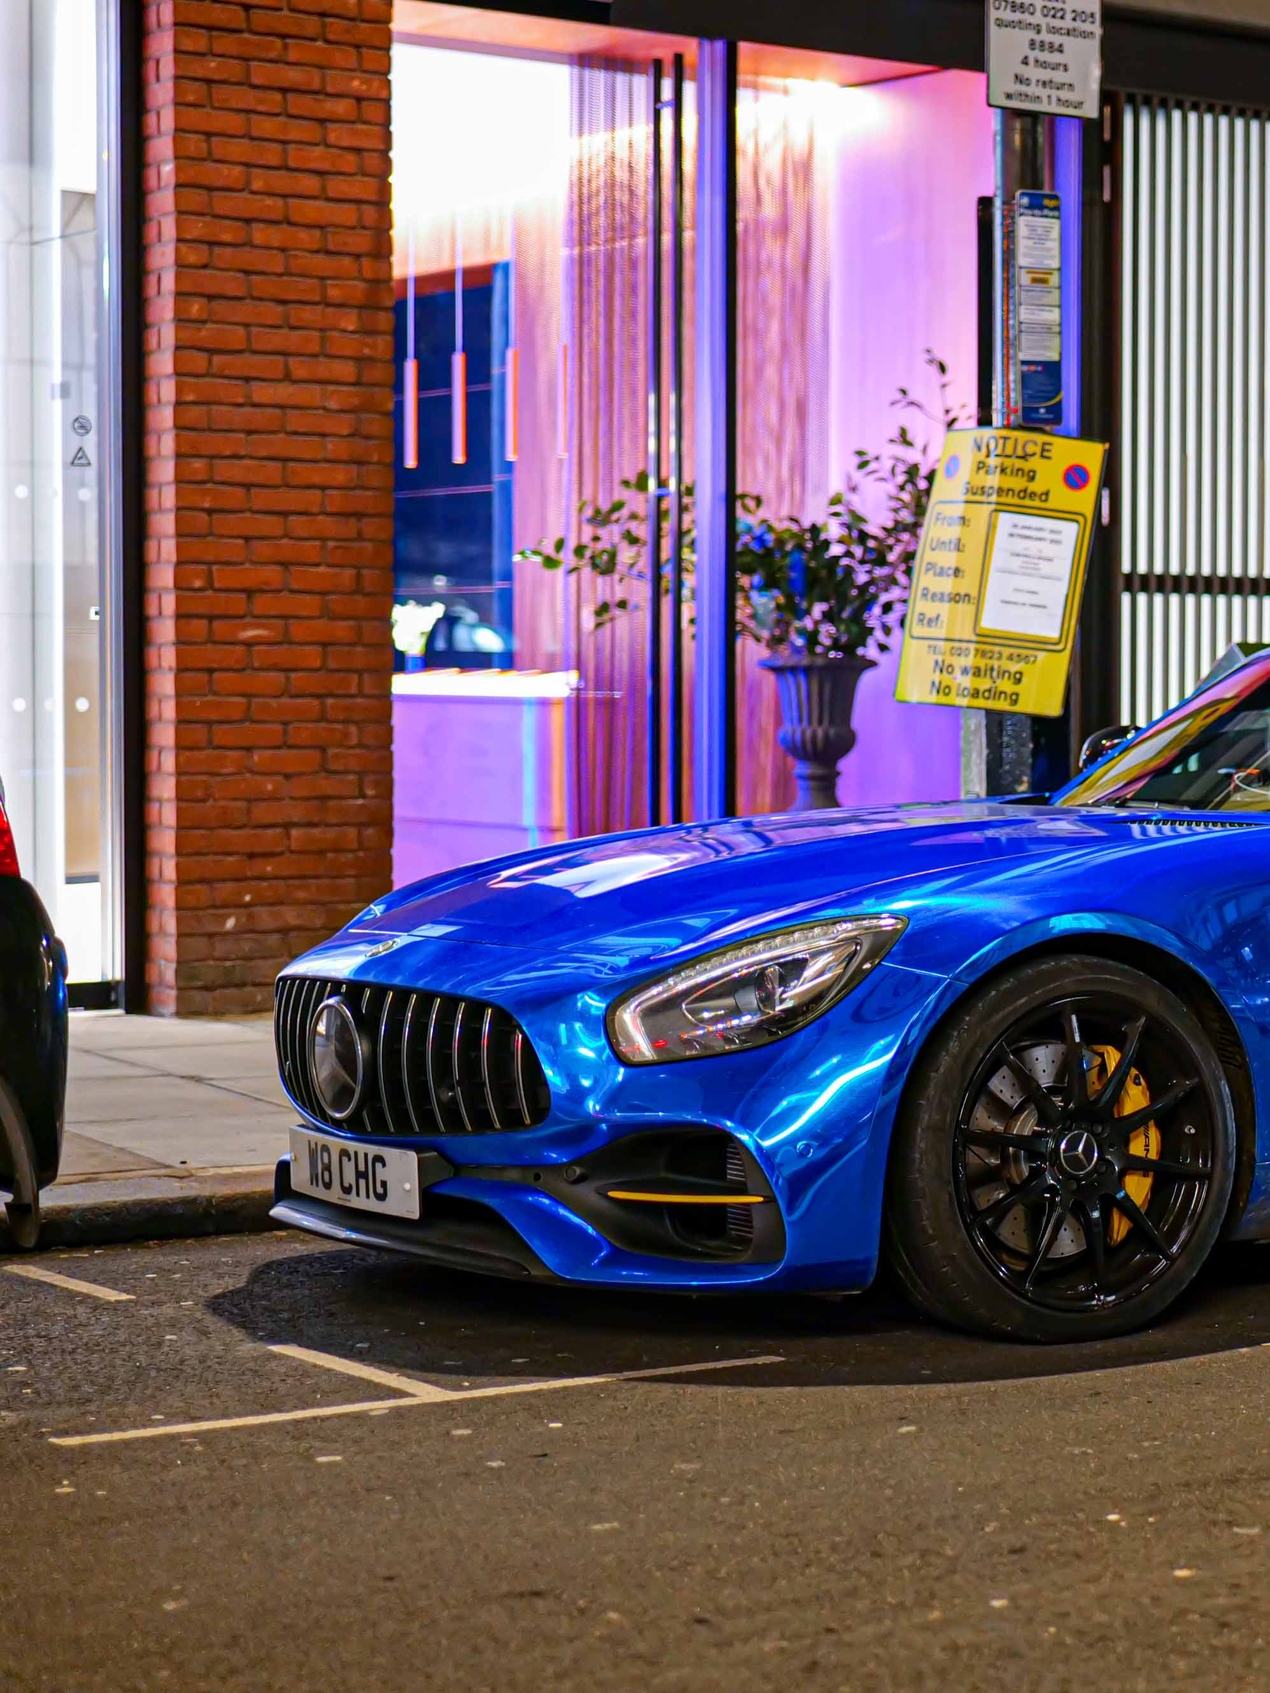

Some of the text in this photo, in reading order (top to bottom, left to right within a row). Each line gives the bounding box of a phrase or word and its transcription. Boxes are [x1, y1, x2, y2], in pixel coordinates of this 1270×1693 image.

[1041, 5, 1067, 20] 022
[1070, 9, 1096, 24] 205
[994, 17, 1096, 39] quoting location
[1020, 55, 1069, 72] 4 hours
[1014, 73, 1075, 92] No return
[1004, 90, 1042, 105] within
[1056, 97, 1085, 110] hour
[972, 434, 1054, 460] NOTICE
[976, 460, 1036, 482] Parking
[962, 481, 1050, 503] Suspended
[934, 511, 970, 527] From:
[930, 537, 965, 552] Until:
[924, 562, 965, 578] Place:
[921, 587, 976, 605] Reason:
[916, 612, 944, 628] Ref:
[933, 659, 1024, 685] No waiting
[930, 680, 1020, 706] No loading
[308, 1139, 388, 1202] W8 CHG
